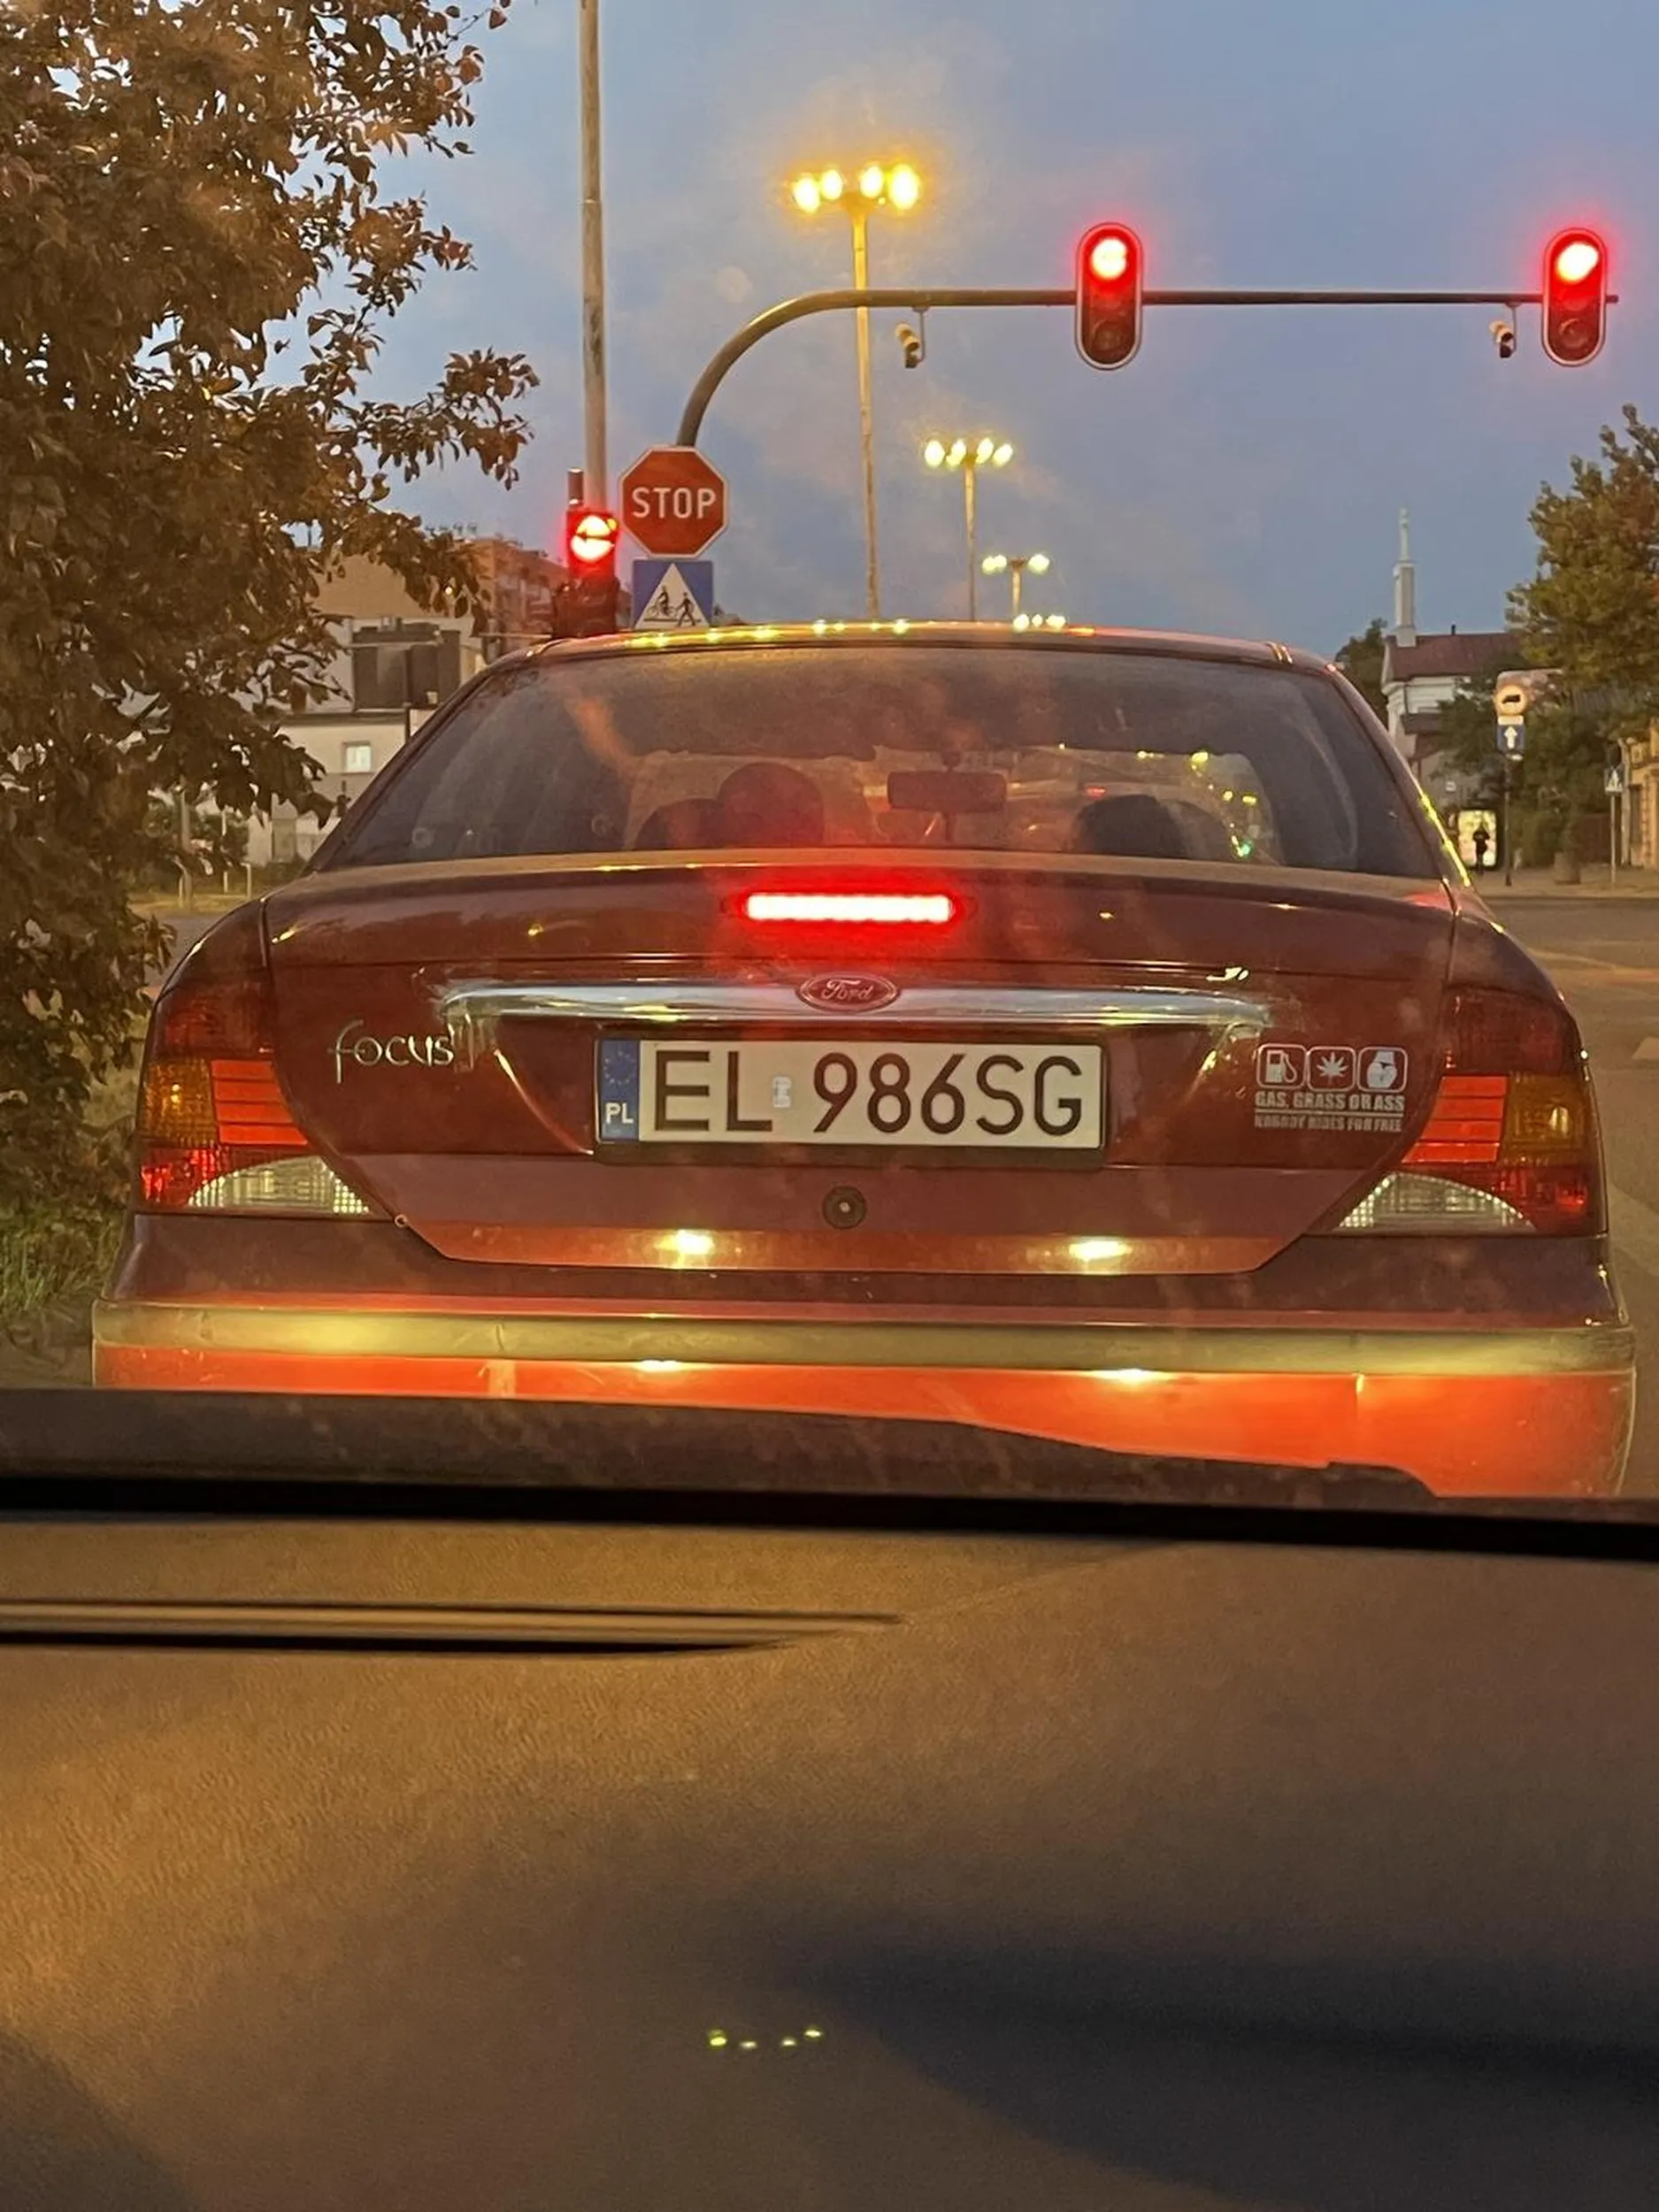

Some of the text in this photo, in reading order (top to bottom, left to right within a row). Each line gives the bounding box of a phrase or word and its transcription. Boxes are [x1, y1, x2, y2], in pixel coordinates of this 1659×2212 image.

[631, 488, 716, 519] STOP
[821, 979, 874, 1000] Ford
[655, 1050, 1083, 1136] EL 986SG
[1293, 1091, 1346, 1110] GRASS
[1348, 1094, 1372, 1111] OR
[1373, 1094, 1405, 1112] ASS
[605, 1102, 634, 1125] PL
